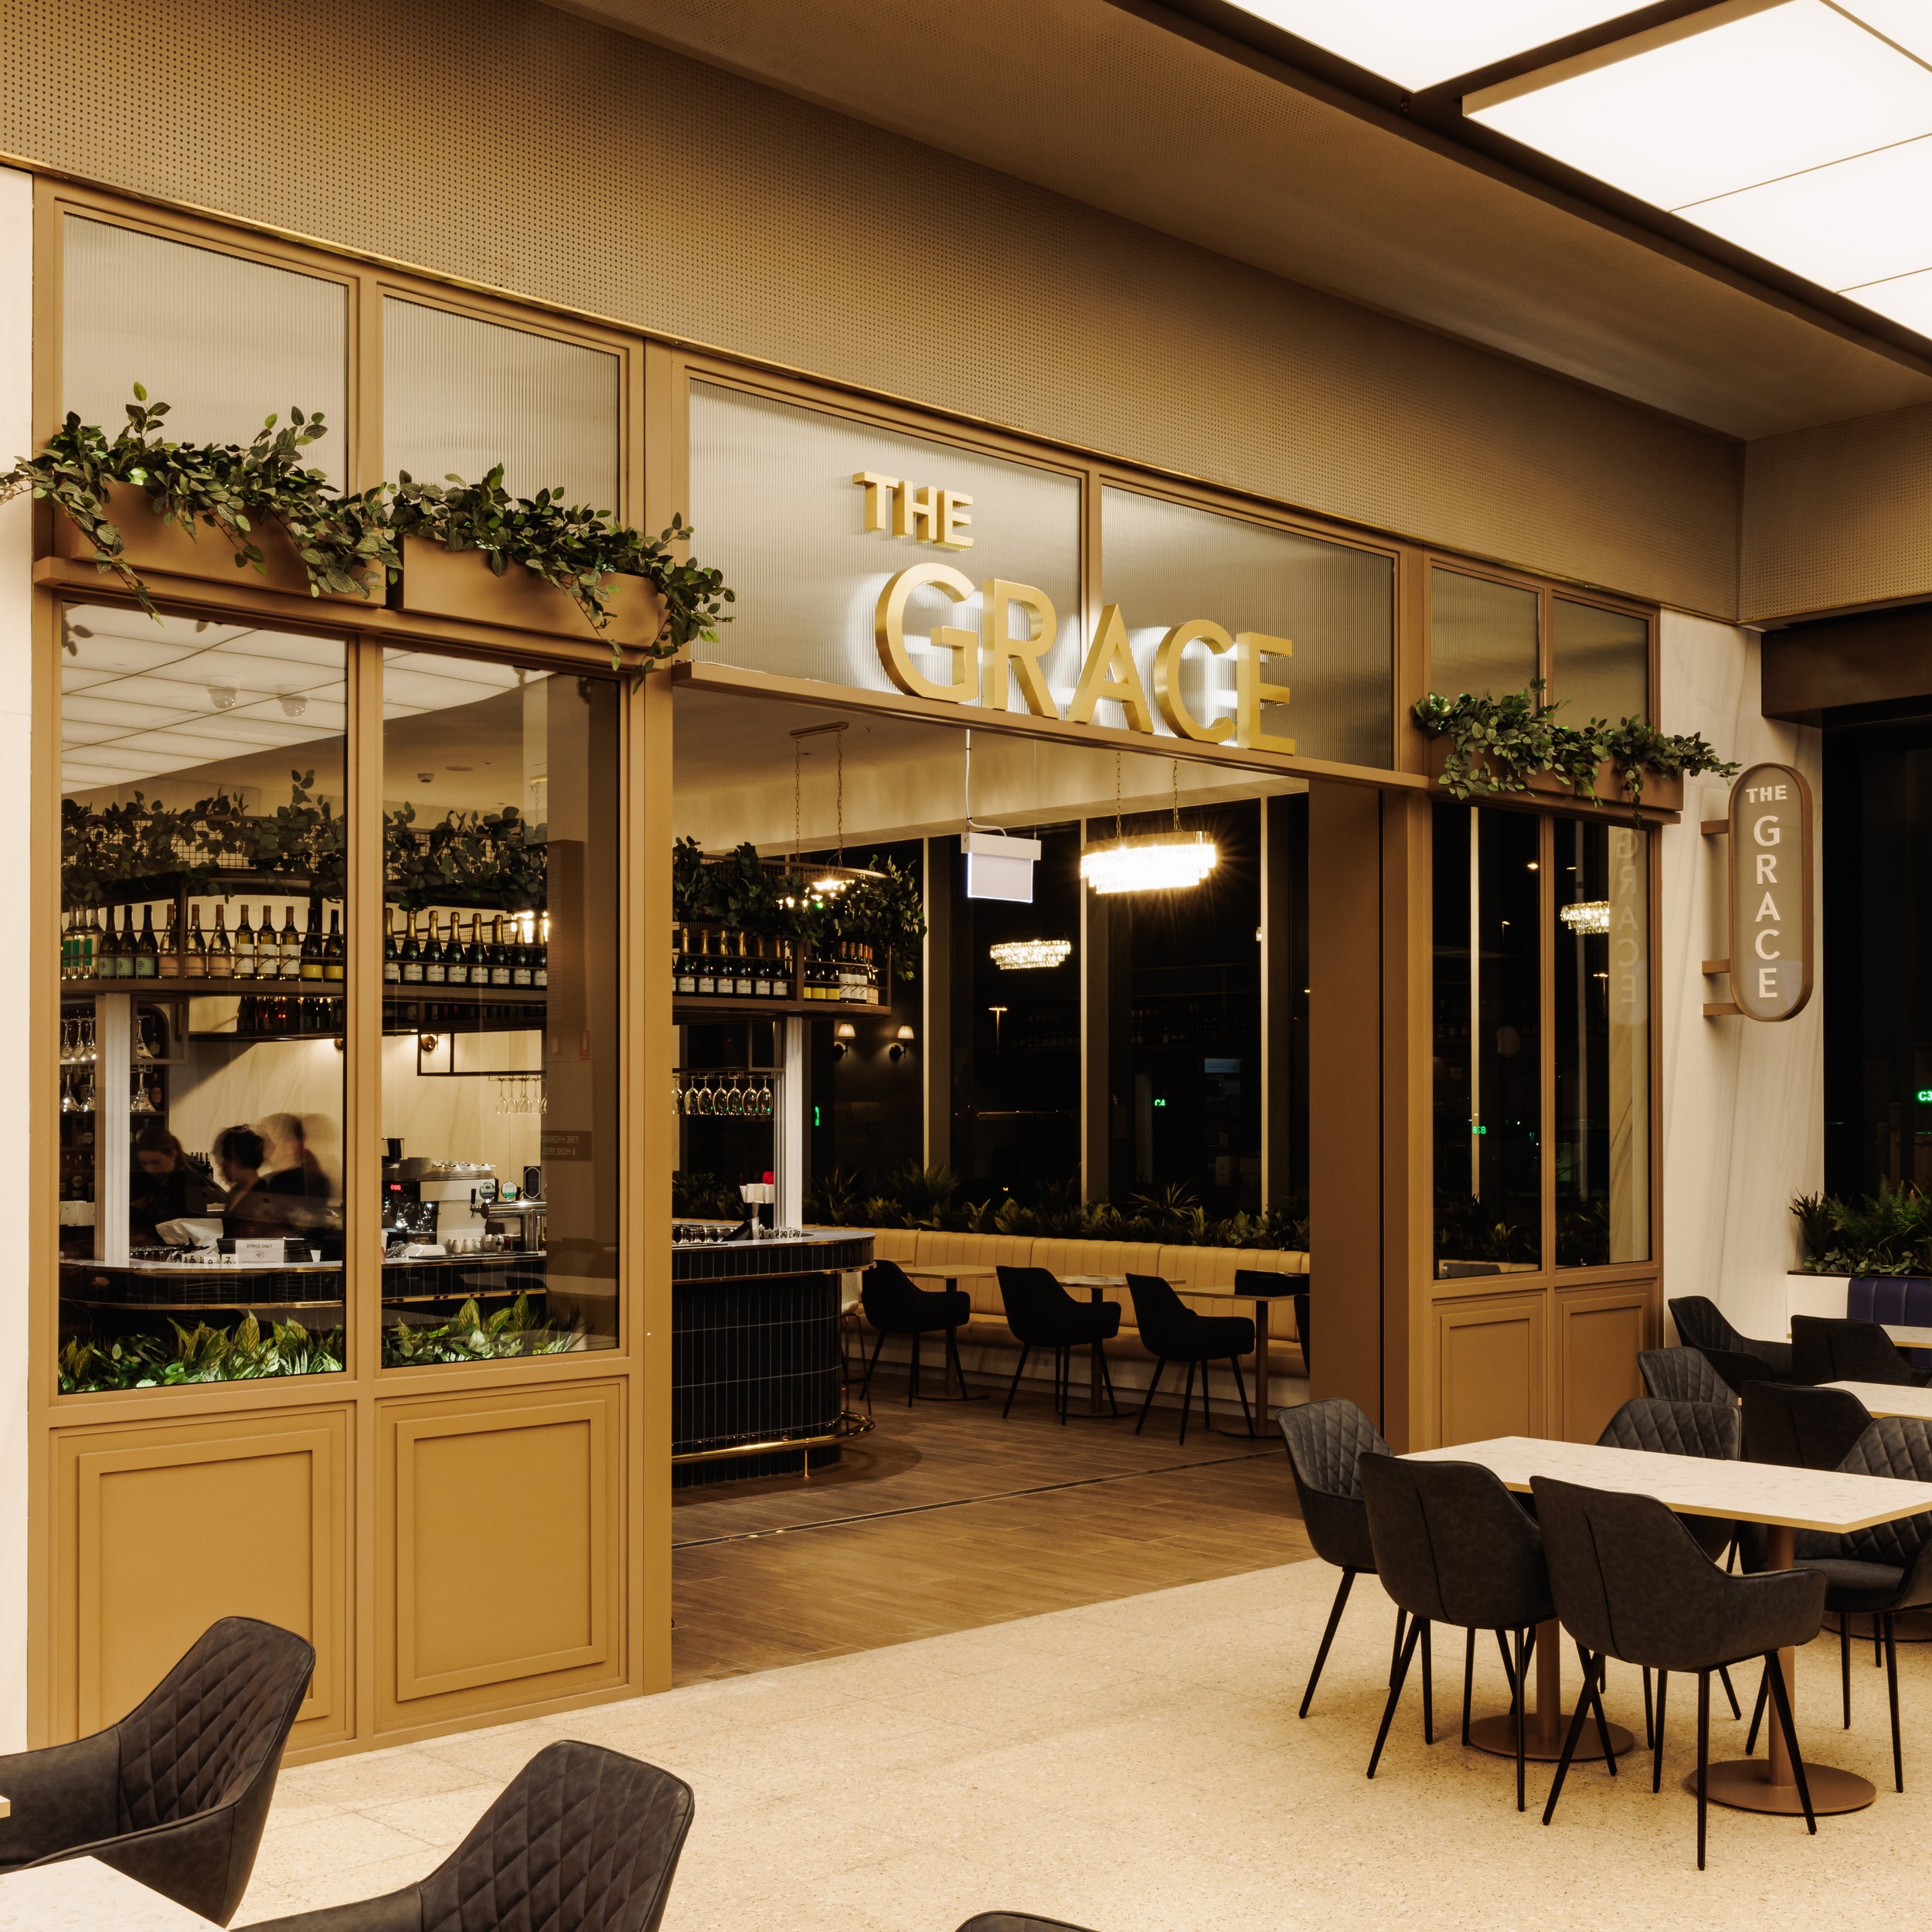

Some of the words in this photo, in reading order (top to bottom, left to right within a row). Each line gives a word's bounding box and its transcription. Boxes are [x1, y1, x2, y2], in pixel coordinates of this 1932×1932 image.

[852, 471, 974, 551] THE
[875, 563, 1295, 755] GRACE
[1746, 784, 1787, 803] THE
[1753, 815, 1781, 998] GRACE
